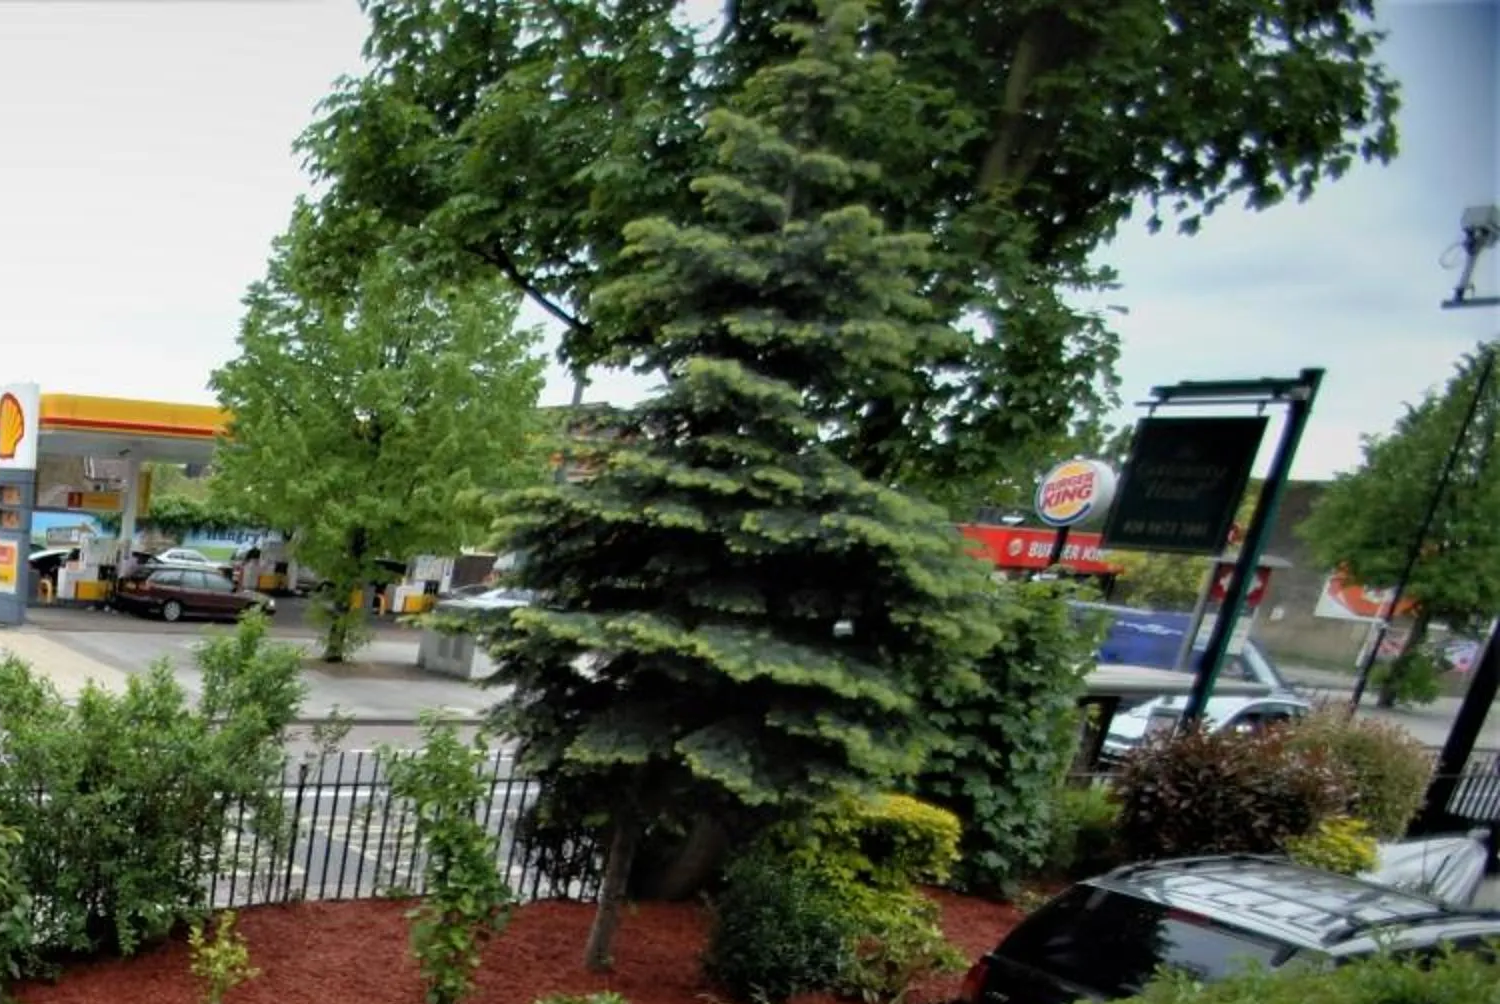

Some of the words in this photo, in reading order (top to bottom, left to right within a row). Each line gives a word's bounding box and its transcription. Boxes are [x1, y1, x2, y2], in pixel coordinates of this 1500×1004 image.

[1045, 471, 1094, 495] BURGER
[1043, 486, 1093, 508] KING
[1028, 541, 1079, 560] BURER
